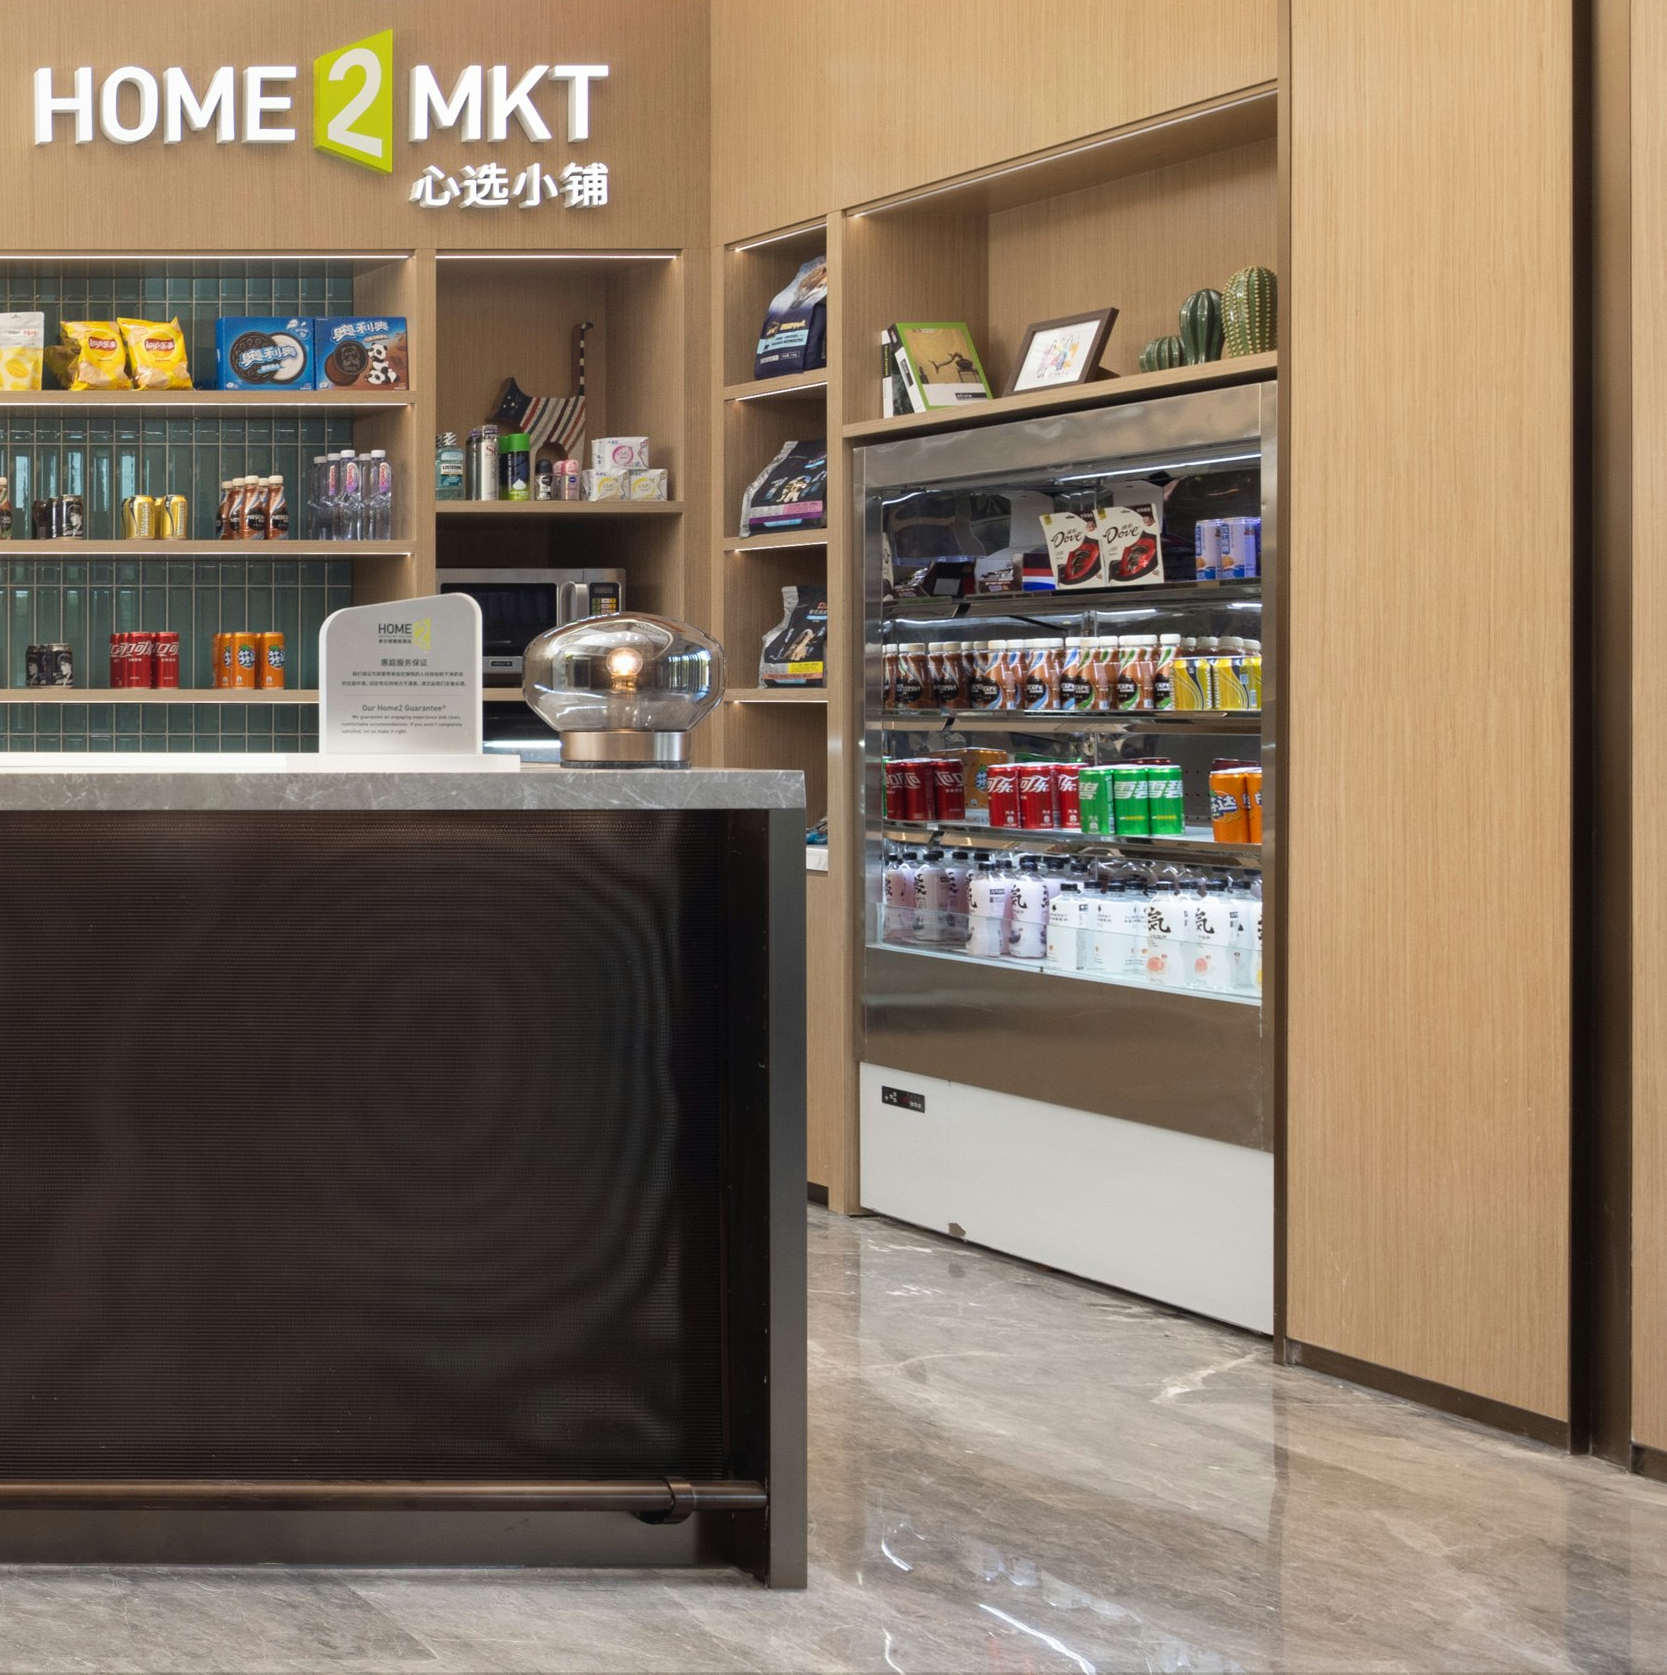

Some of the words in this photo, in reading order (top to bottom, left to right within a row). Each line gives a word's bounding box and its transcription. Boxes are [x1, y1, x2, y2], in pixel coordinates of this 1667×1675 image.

[34, 65, 297, 146] HOME
[326, 46, 383, 159] 2
[409, 64, 610, 144] MKT
[410, 161, 610, 209] 心选小铺
[1051, 531, 1082, 548] Dove
[1103, 526, 1138, 544] Dove
[378, 623, 412, 635] HOME
[362, 704, 375, 712] Our
[377, 704, 403, 712] Home2
